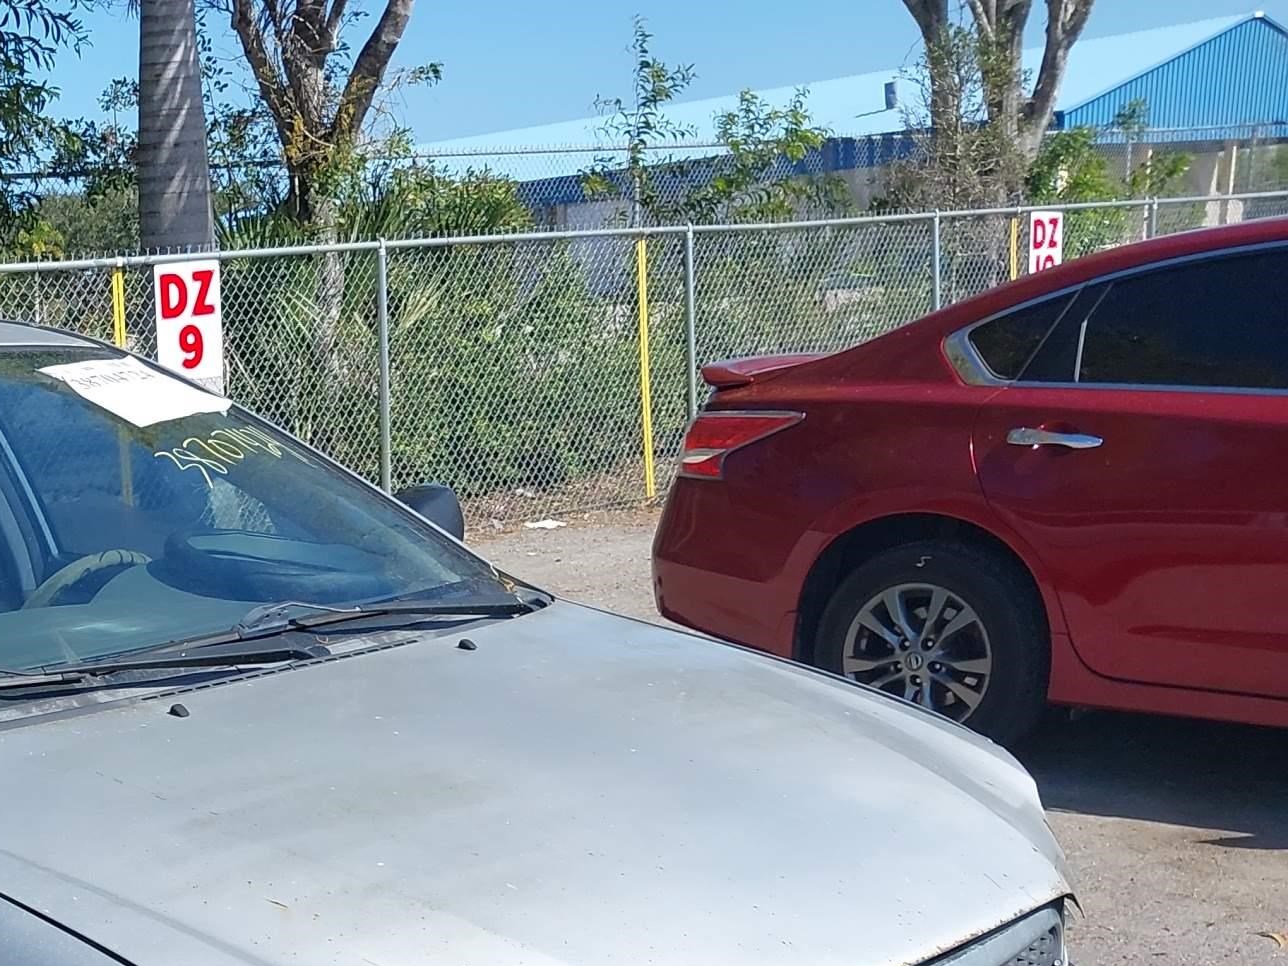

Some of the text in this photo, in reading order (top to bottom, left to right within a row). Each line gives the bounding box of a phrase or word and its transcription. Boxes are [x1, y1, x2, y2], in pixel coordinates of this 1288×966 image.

[1033, 217, 1058, 249] DZ
[159, 269, 215, 319] DZ
[179, 324, 204, 369] 9
